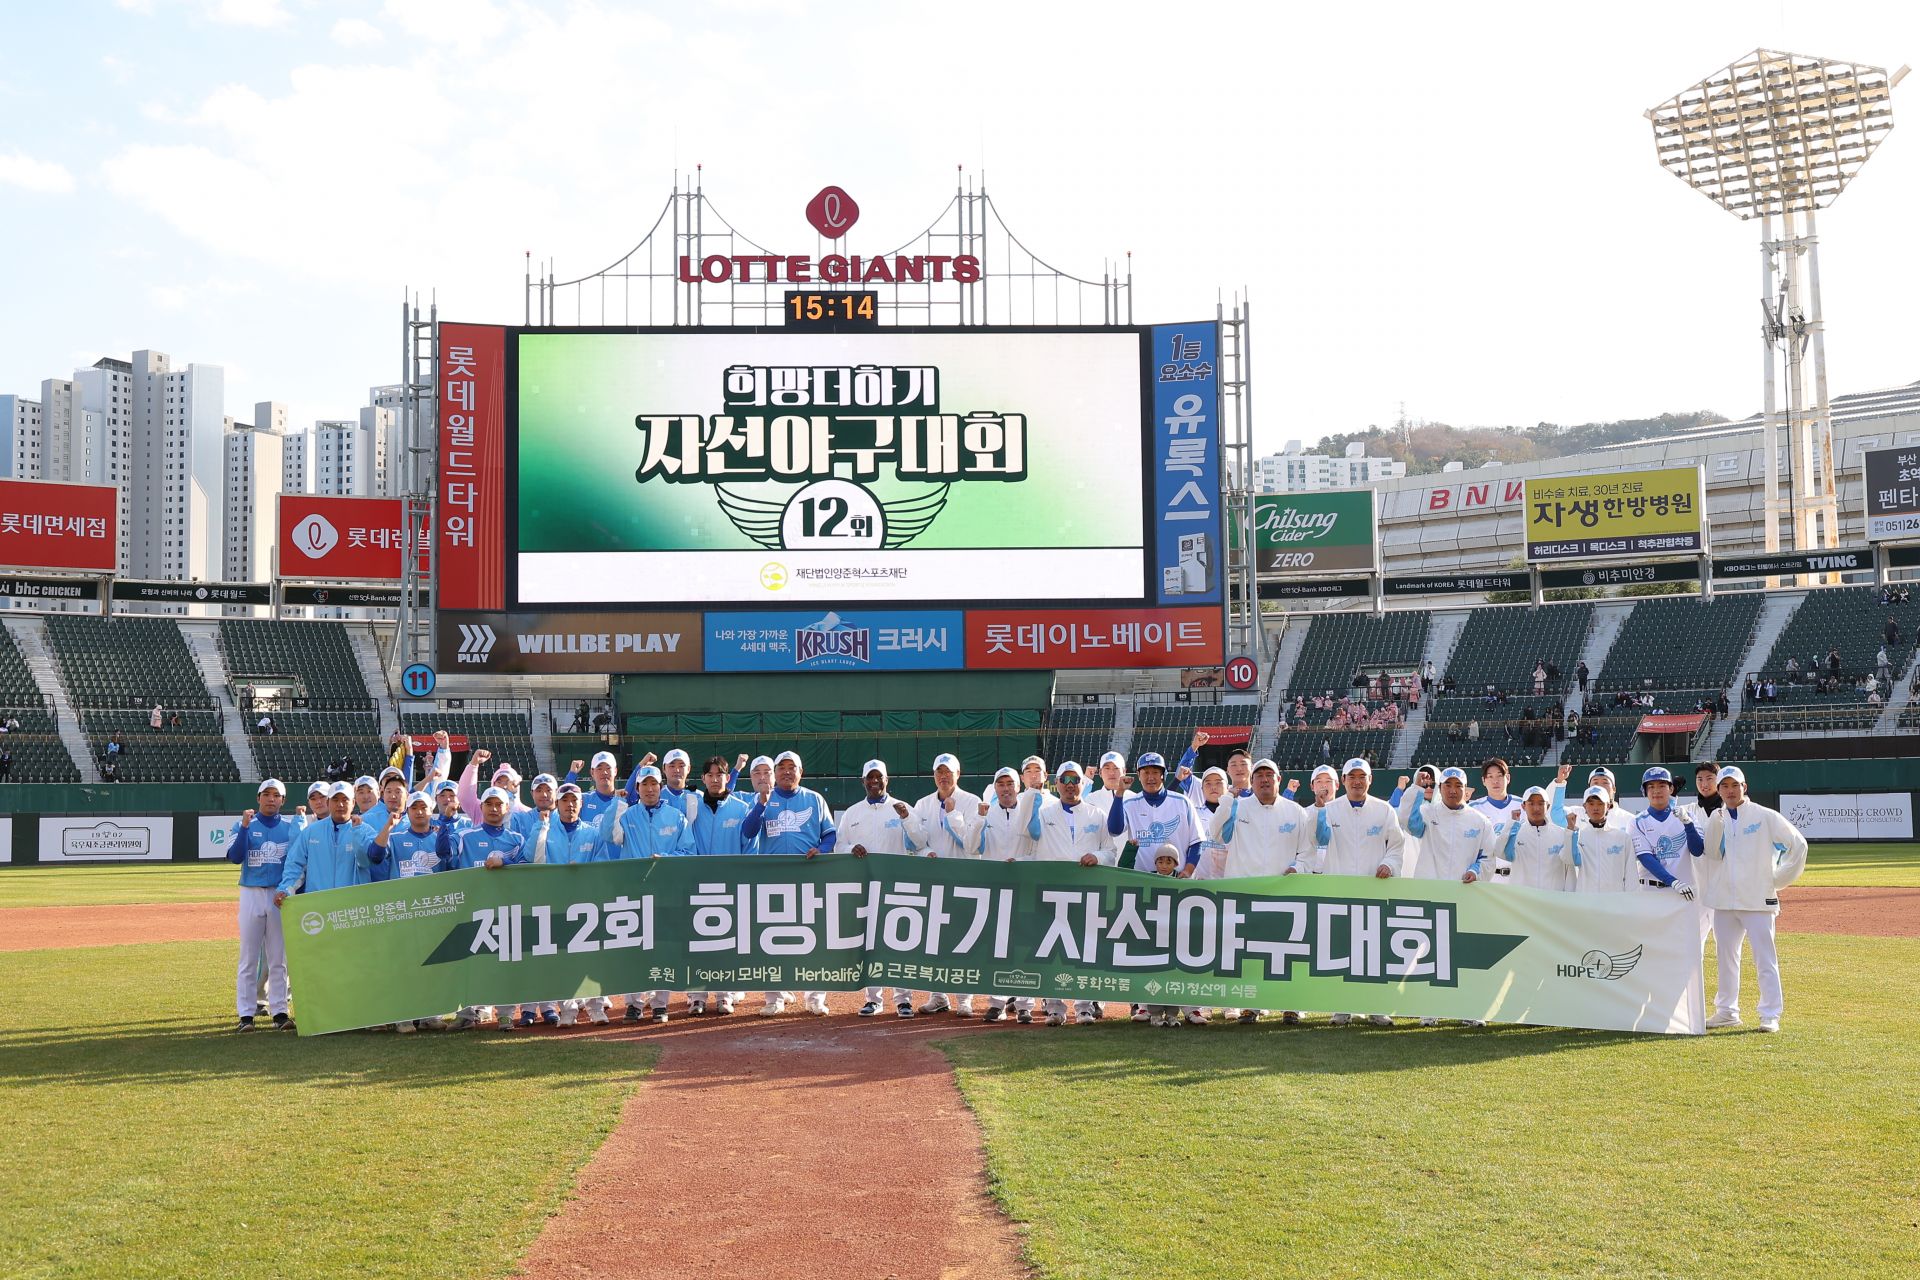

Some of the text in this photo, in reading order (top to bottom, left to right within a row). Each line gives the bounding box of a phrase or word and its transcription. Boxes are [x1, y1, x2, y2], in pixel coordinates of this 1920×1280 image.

[679, 254, 980, 283] LOTTE GIANTS
[789, 295, 874, 320] 15:14
[1171, 333, 1202, 361] 1등
[1159, 362, 1213, 382] 요소수
[727, 366, 937, 407] 희망더하기
[445, 346, 479, 547] 롯데월드타워
[640, 411, 1024, 475] 자선야구대회
[1164, 394, 1210, 521] 유록스
[1897, 453, 1917, 466] 부산
[1533, 482, 1644, 500] 비수술 치료, 30년 진료
[1878, 486, 1918, 509] 펜타
[798, 497, 873, 538] 12회
[1533, 493, 1692, 528] 자생한방병원
[0, 513, 106, 539] 롯데면세점
[1246, 504, 1338, 538] Chilsung
[1270, 529, 1314, 542] Cider
[1534, 536, 1693, 556] 허리디스크 목디스크 척추관협착증
[1270, 552, 1314, 568] ZERO
[1807, 555, 1857, 570] TVING
[796, 567, 907, 579] 재단법인양준혁스포츠재단
[1598, 567, 1655, 583] 비추미안경
[15, 581, 40, 595] bhc
[41, 586, 81, 597] CHICKEN
[1457, 578, 1511, 589] 롯데월드타워
[180, 589, 193, 597] 나라
[210, 589, 247, 599] 롯데월드
[517, 633, 681, 653] WILLBE PLAY
[715, 629, 788, 641] 나와 가장 가까운
[877, 627, 947, 652] 크러시
[985, 621, 1207, 654] 롯데이노베이트
[740, 641, 791, 654] 4세대 맥주,
[795, 628, 870, 665] KRUSH
[457, 653, 489, 663] PLAY
[408, 671, 428, 691] 11
[1231, 664, 1252, 682] 10
[1818, 808, 1903, 817] WEDDING CROWD
[327, 891, 466, 924] 재단법인 양준혁 스포츠재단
[333, 905, 458, 931] YANG JUN HYUK SPORTS FOUNDATION
[470, 881, 1450, 981] 제12회 희망더하기 자선야구대회
[648, 966, 675, 983] 후원
[699, 969, 735, 983] 이야기
[738, 965, 782, 982] 모바일
[795, 967, 861, 982] Herbalife
[888, 962, 981, 985] 근로복지공단
[1076, 975, 1131, 992] 동화약품
[1231, 984, 1257, 999] 식품
[1557, 963, 1596, 979] HOPE
